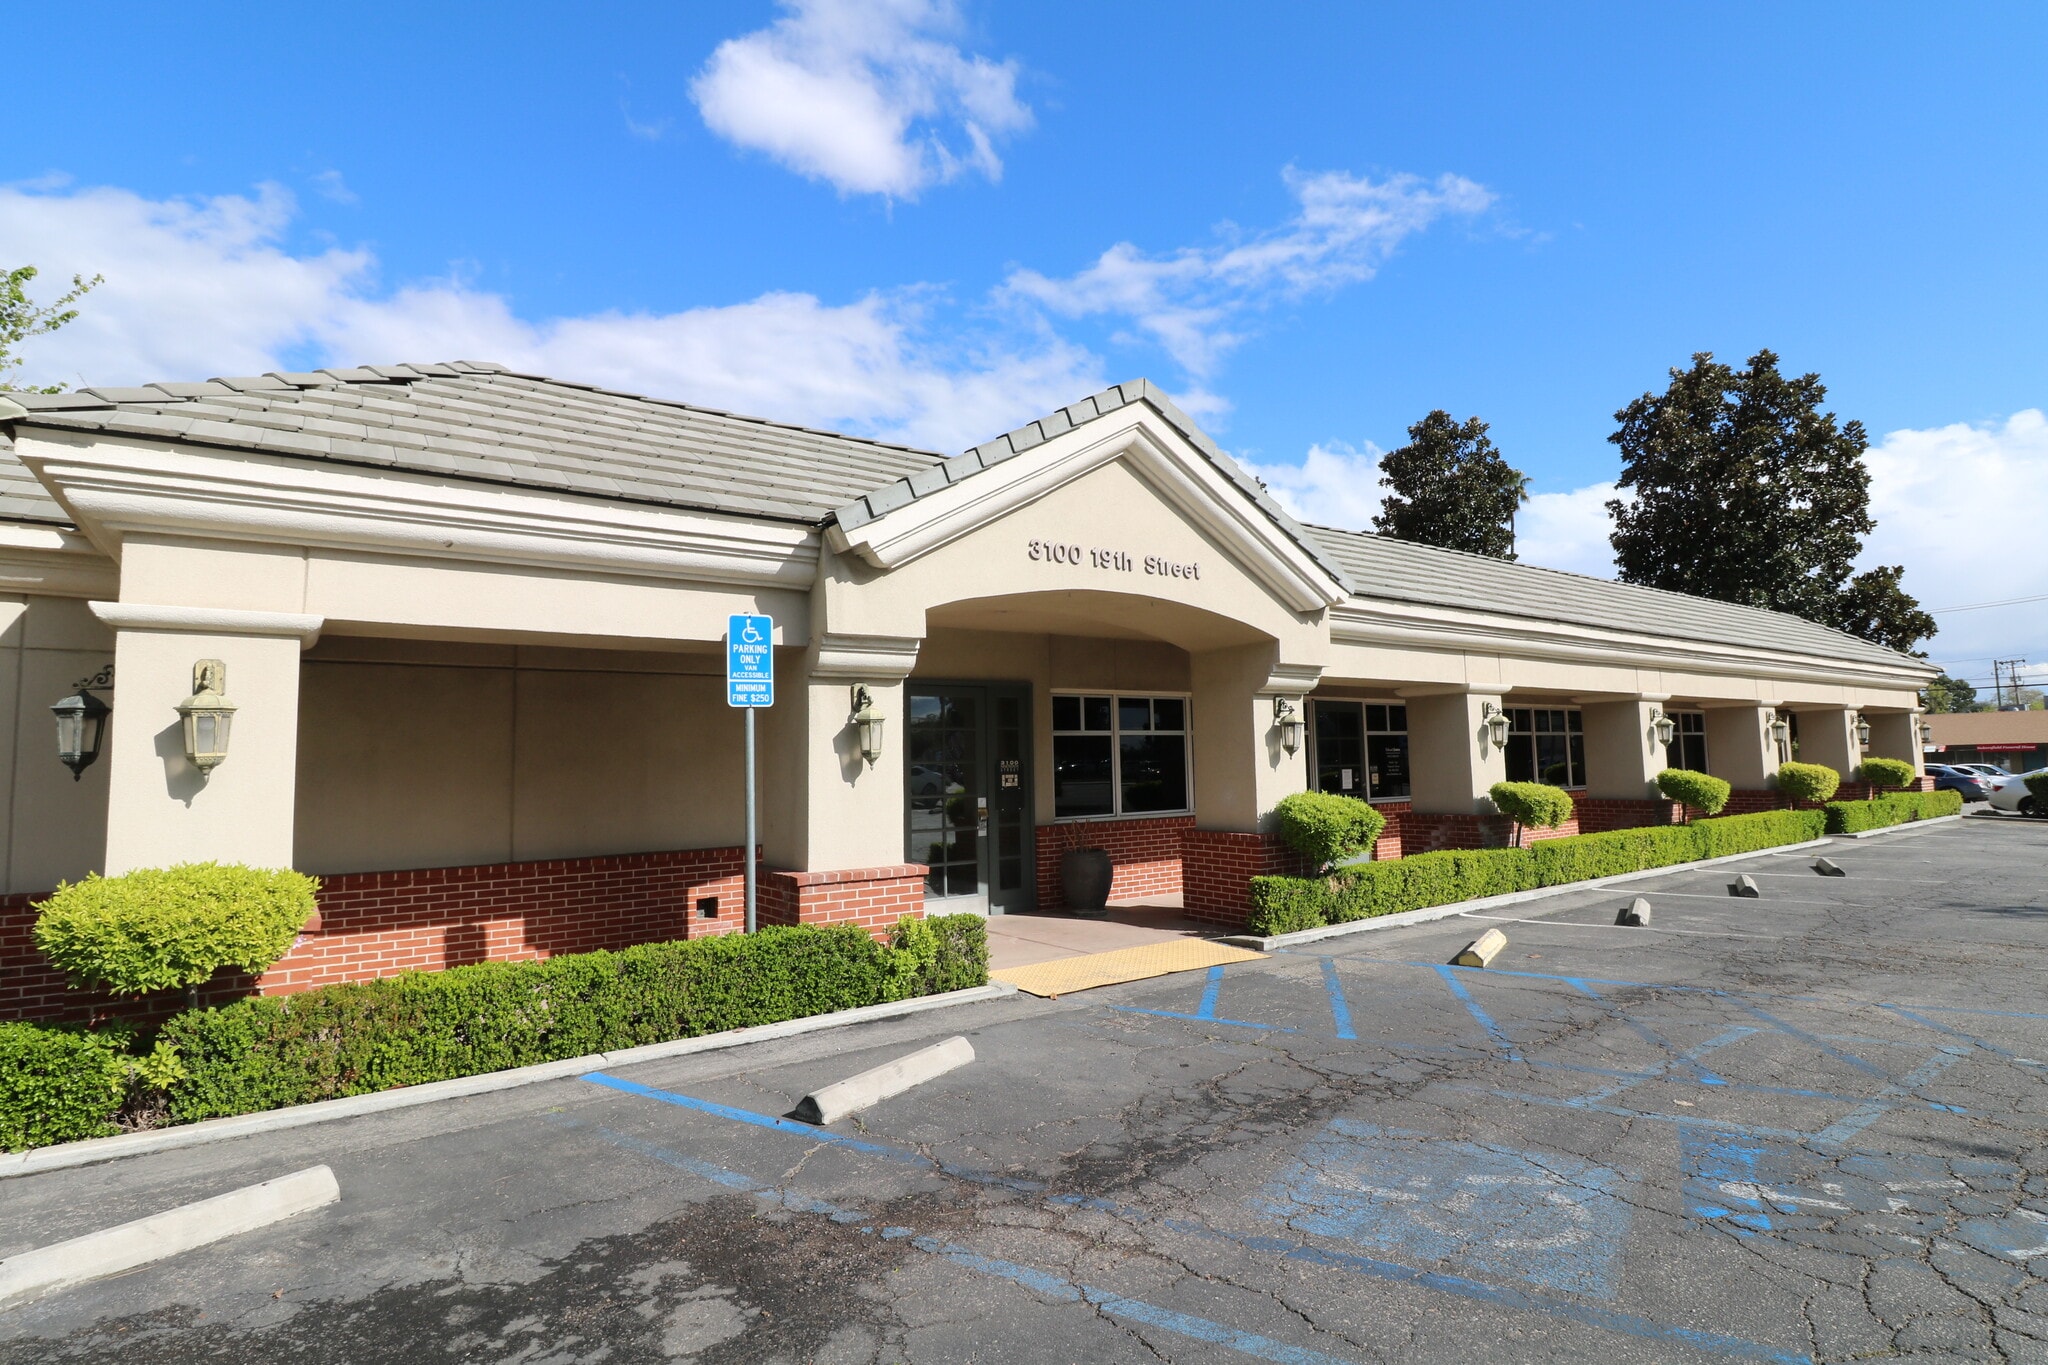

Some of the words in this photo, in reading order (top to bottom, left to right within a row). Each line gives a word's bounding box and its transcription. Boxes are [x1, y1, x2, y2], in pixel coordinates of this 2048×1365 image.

[1027, 538, 1083, 565] 3100
[1090, 547, 1133, 573] 19th
[1143, 554, 1201, 580] Street
[733, 644, 768, 654] PARKING
[740, 654, 761, 664] ONLY
[735, 684, 766, 692] MINIMUM
[732, 694, 748, 702] FINE
[751, 694, 769, 702] $250
